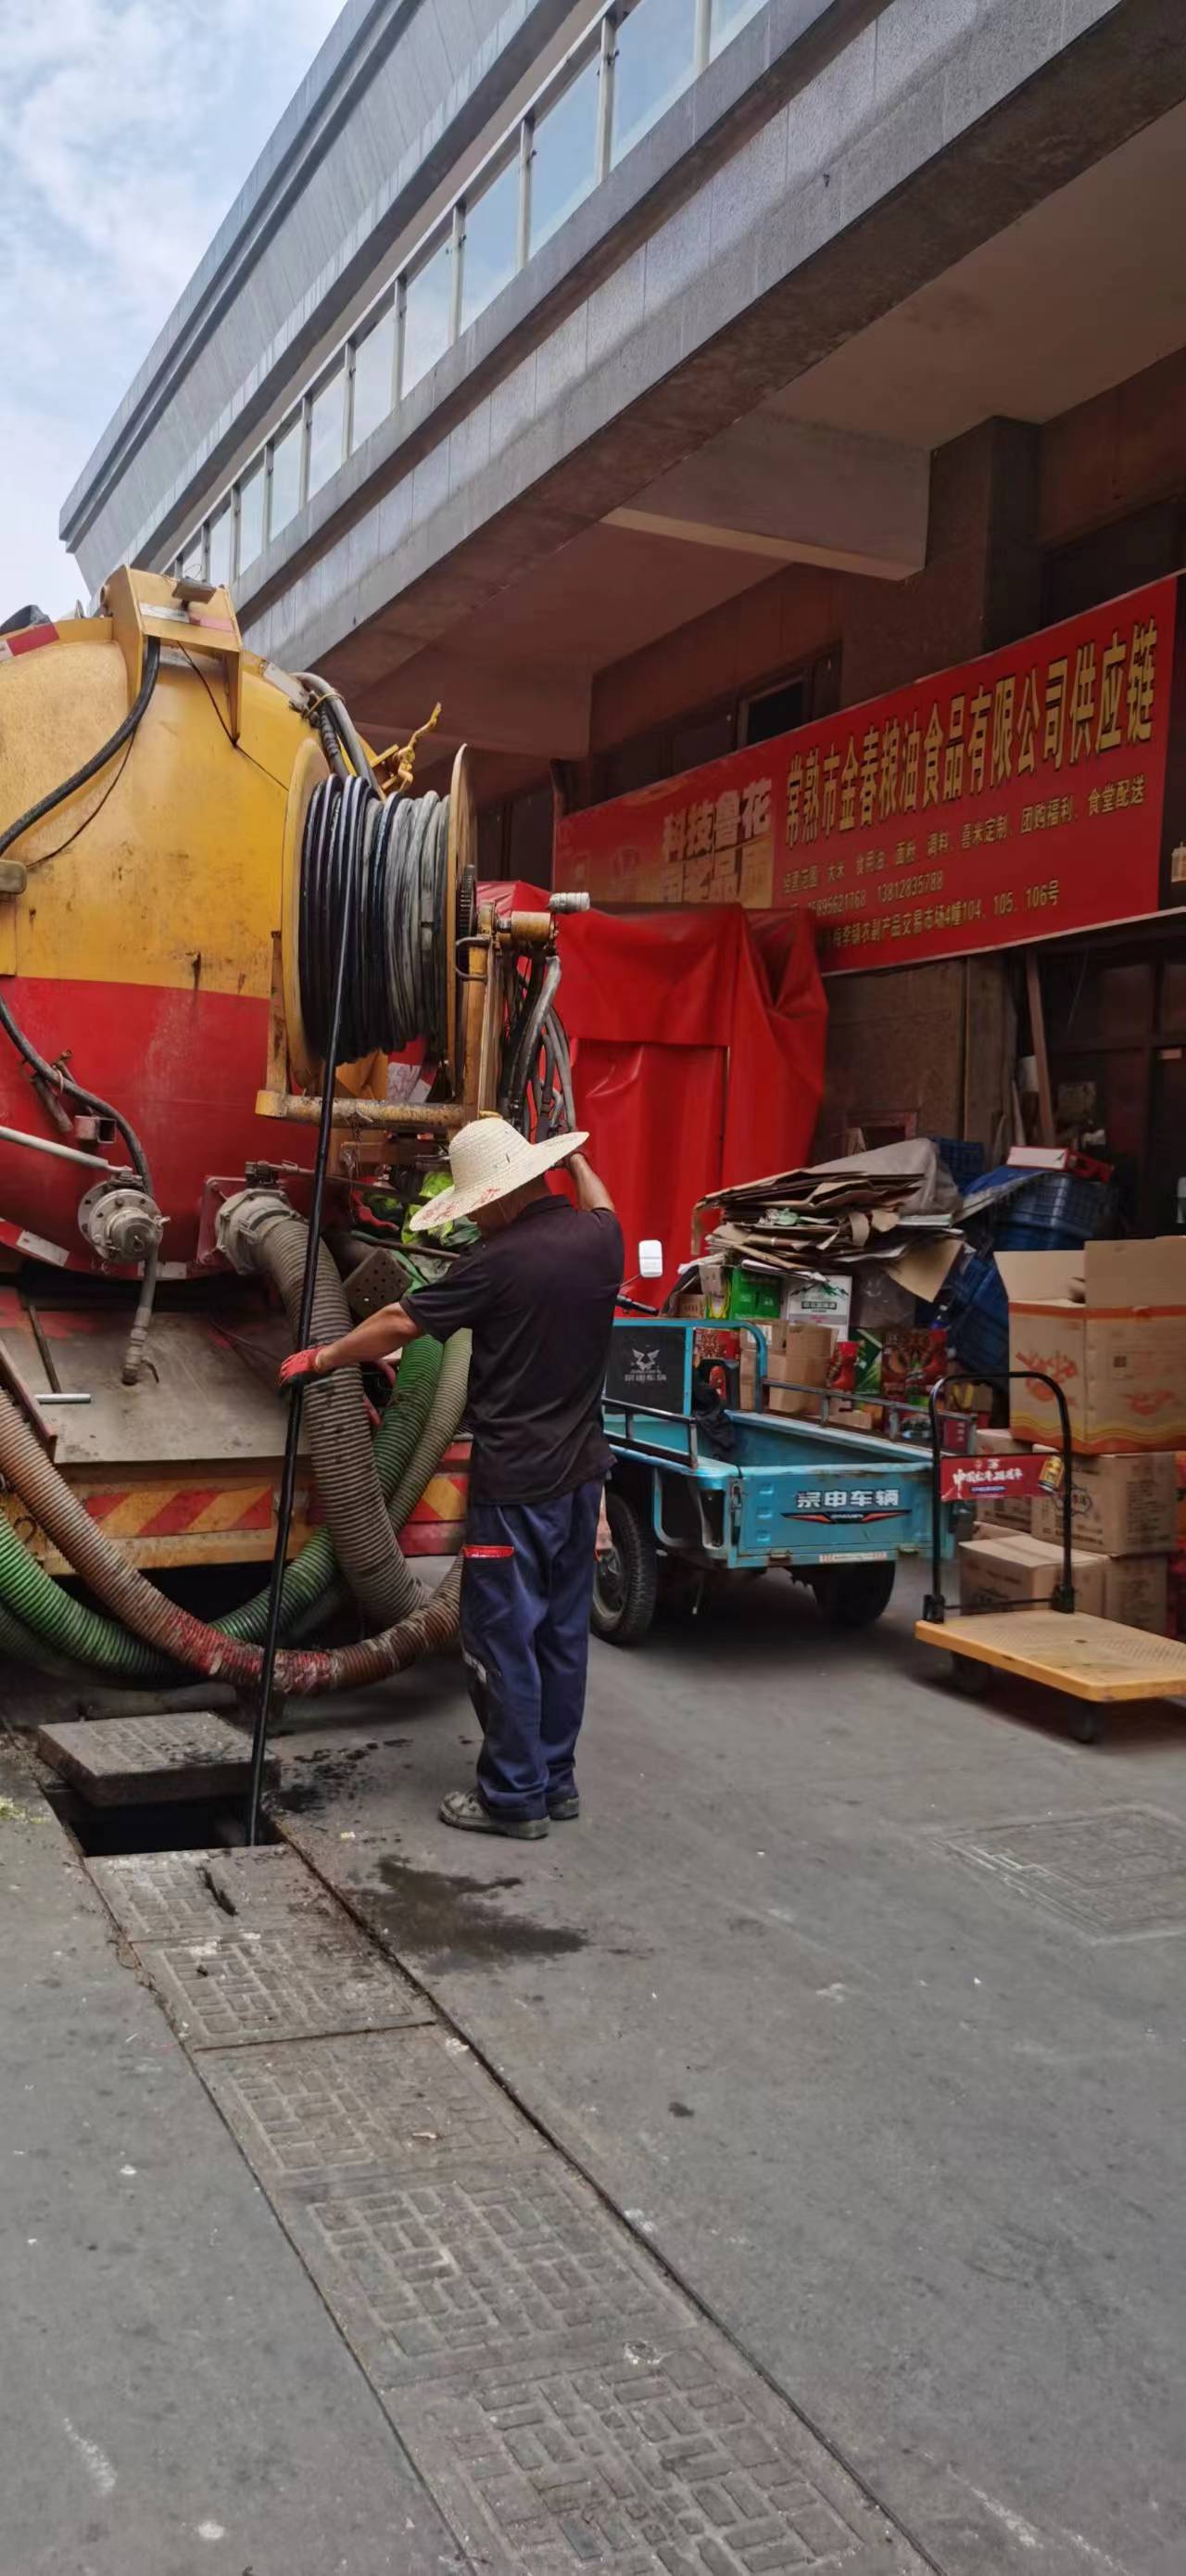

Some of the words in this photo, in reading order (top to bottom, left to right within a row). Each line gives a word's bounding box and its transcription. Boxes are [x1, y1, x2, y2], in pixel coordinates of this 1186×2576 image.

[785, 616, 1157, 848] 常熟市金春粮油食品有限公司供应链
[662, 777, 772, 863] 科技鲁花
[797, 1489, 900, 1508] 宗申车辆
